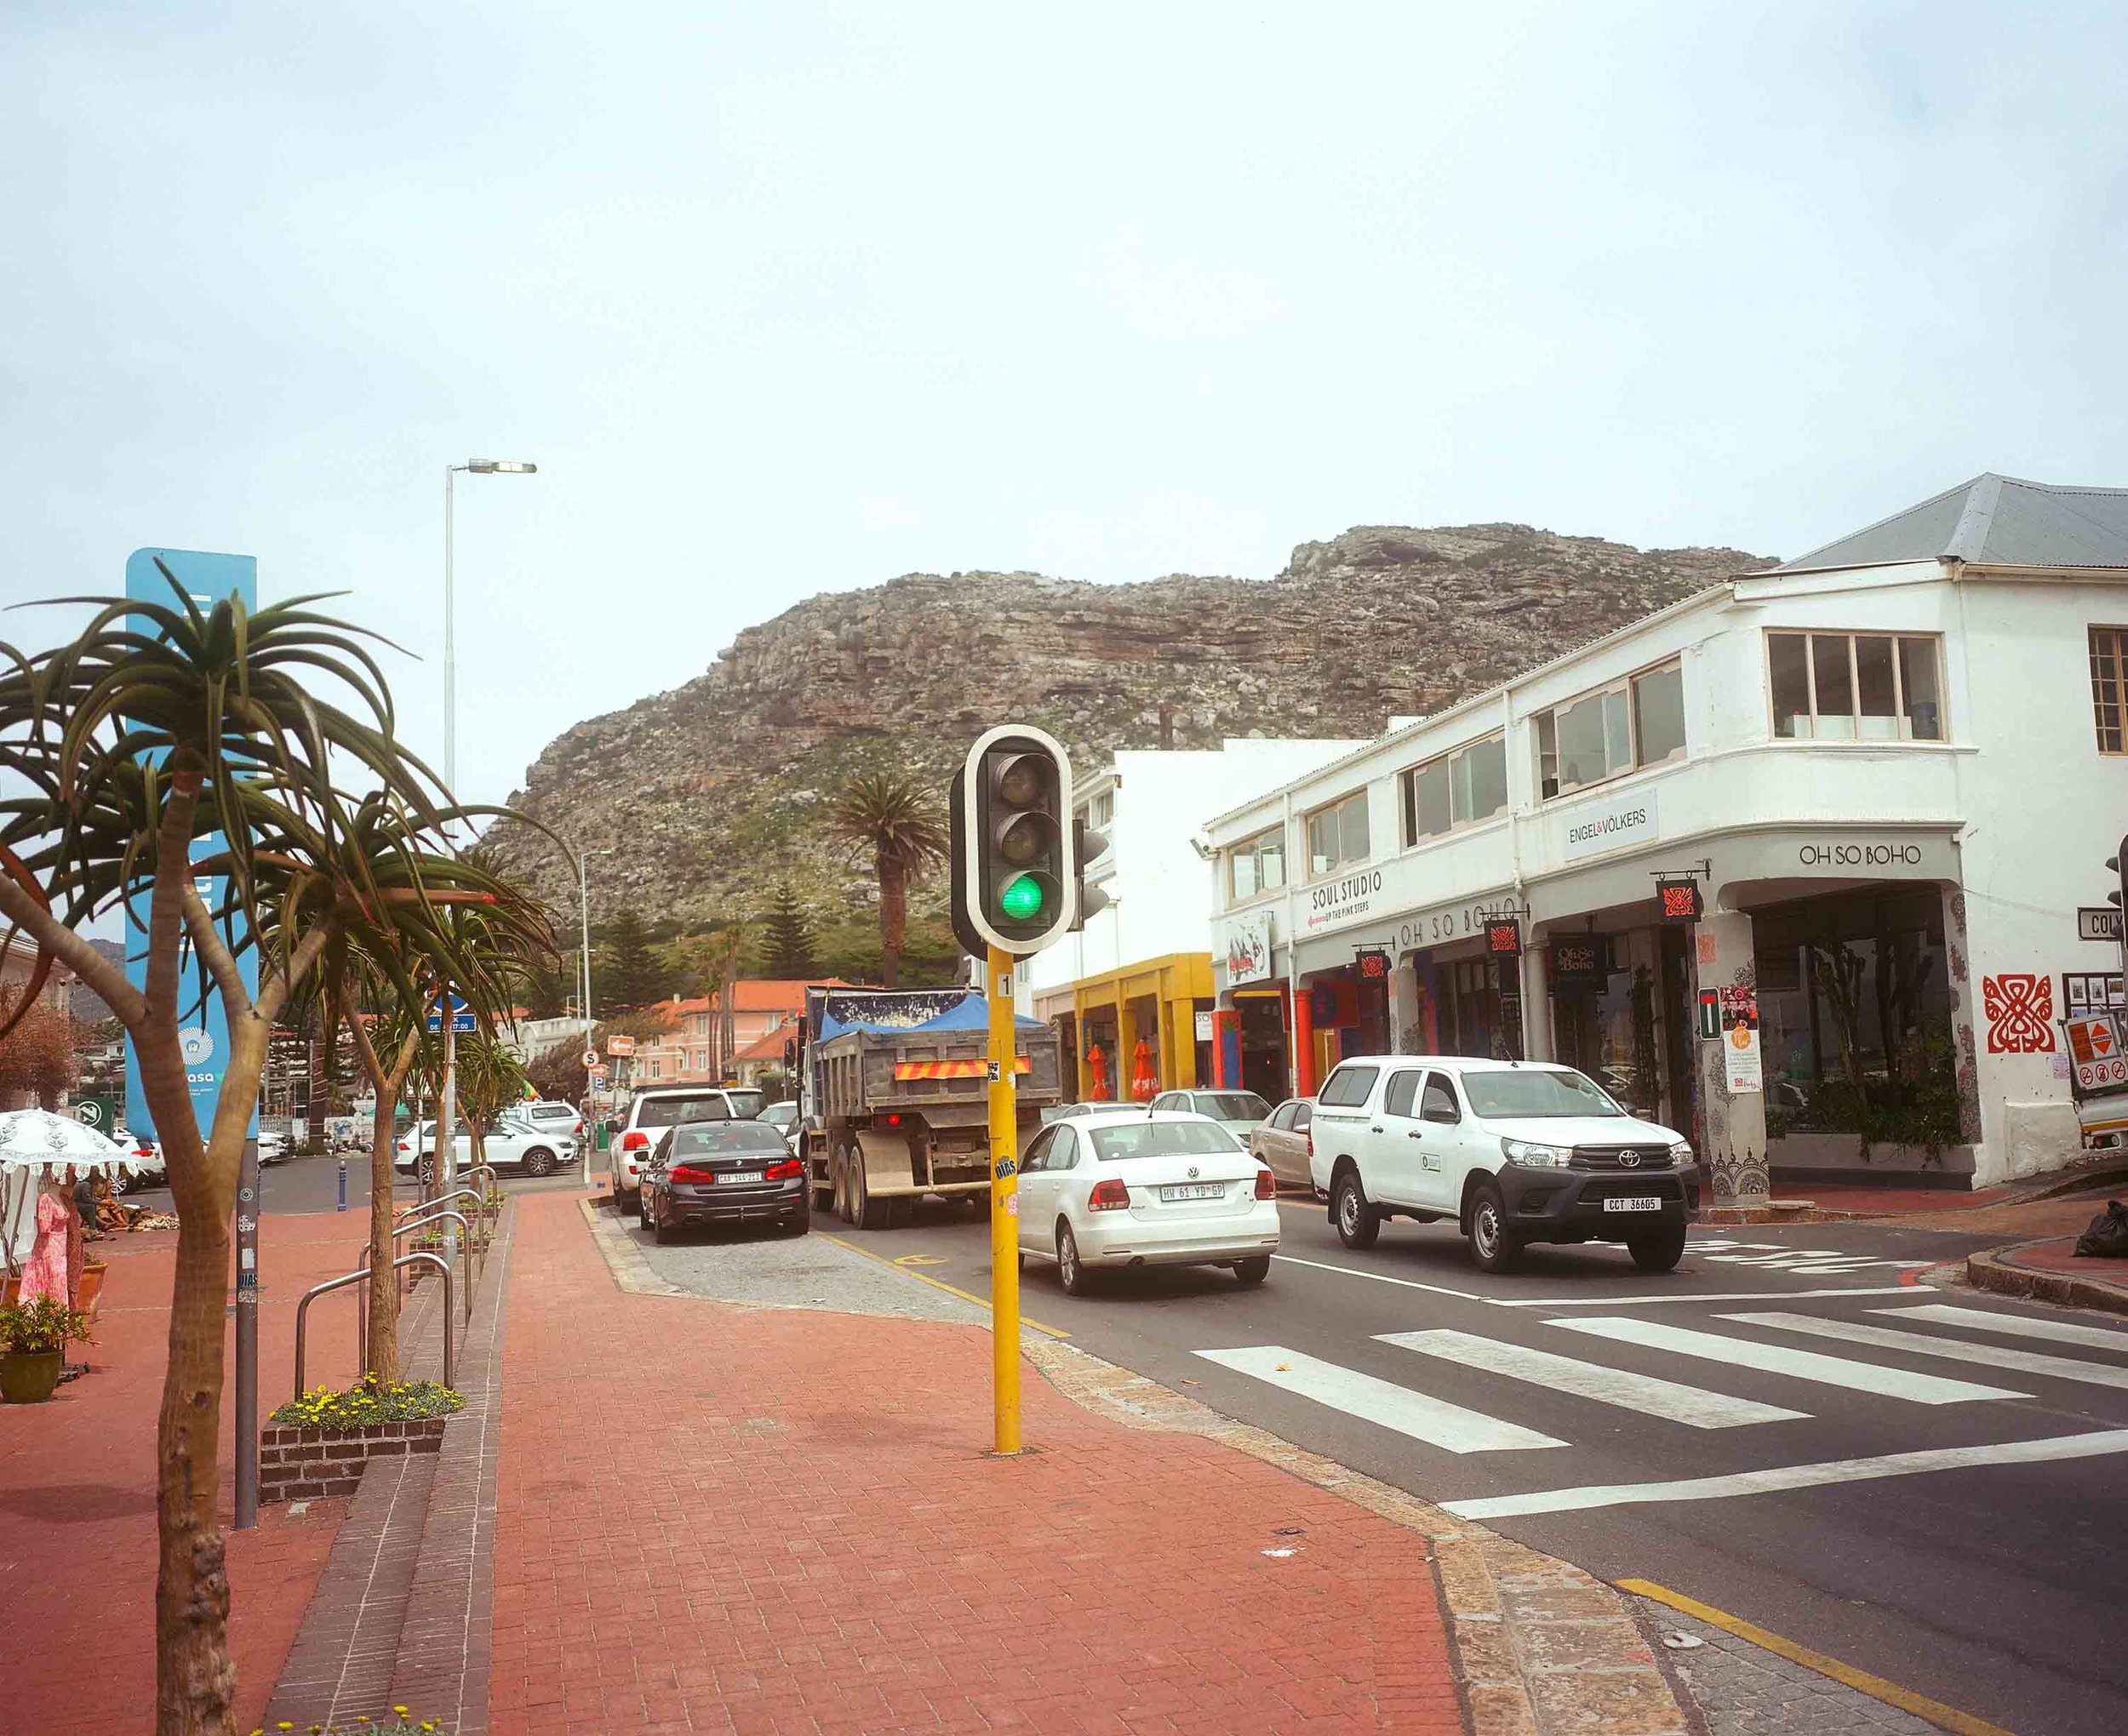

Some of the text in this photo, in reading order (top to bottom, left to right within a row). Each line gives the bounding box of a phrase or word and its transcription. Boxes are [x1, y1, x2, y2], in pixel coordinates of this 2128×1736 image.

[1799, 844, 1921, 865] OH SO BOHO
[1313, 871, 1381, 911] SOUL STUDIO
[1332, 908, 1341, 920] THE
[1341, 905, 1353, 917] PINK
[1354, 899, 1369, 914] STEPS
[1401, 898, 1515, 946] OH SO BOHO
[1002, 975, 1009, 995] 1
[587, 1054, 595, 1064] S
[1212, 1185, 1222, 1196] GP
[1609, 1198, 1656, 1210] CCT 36605
